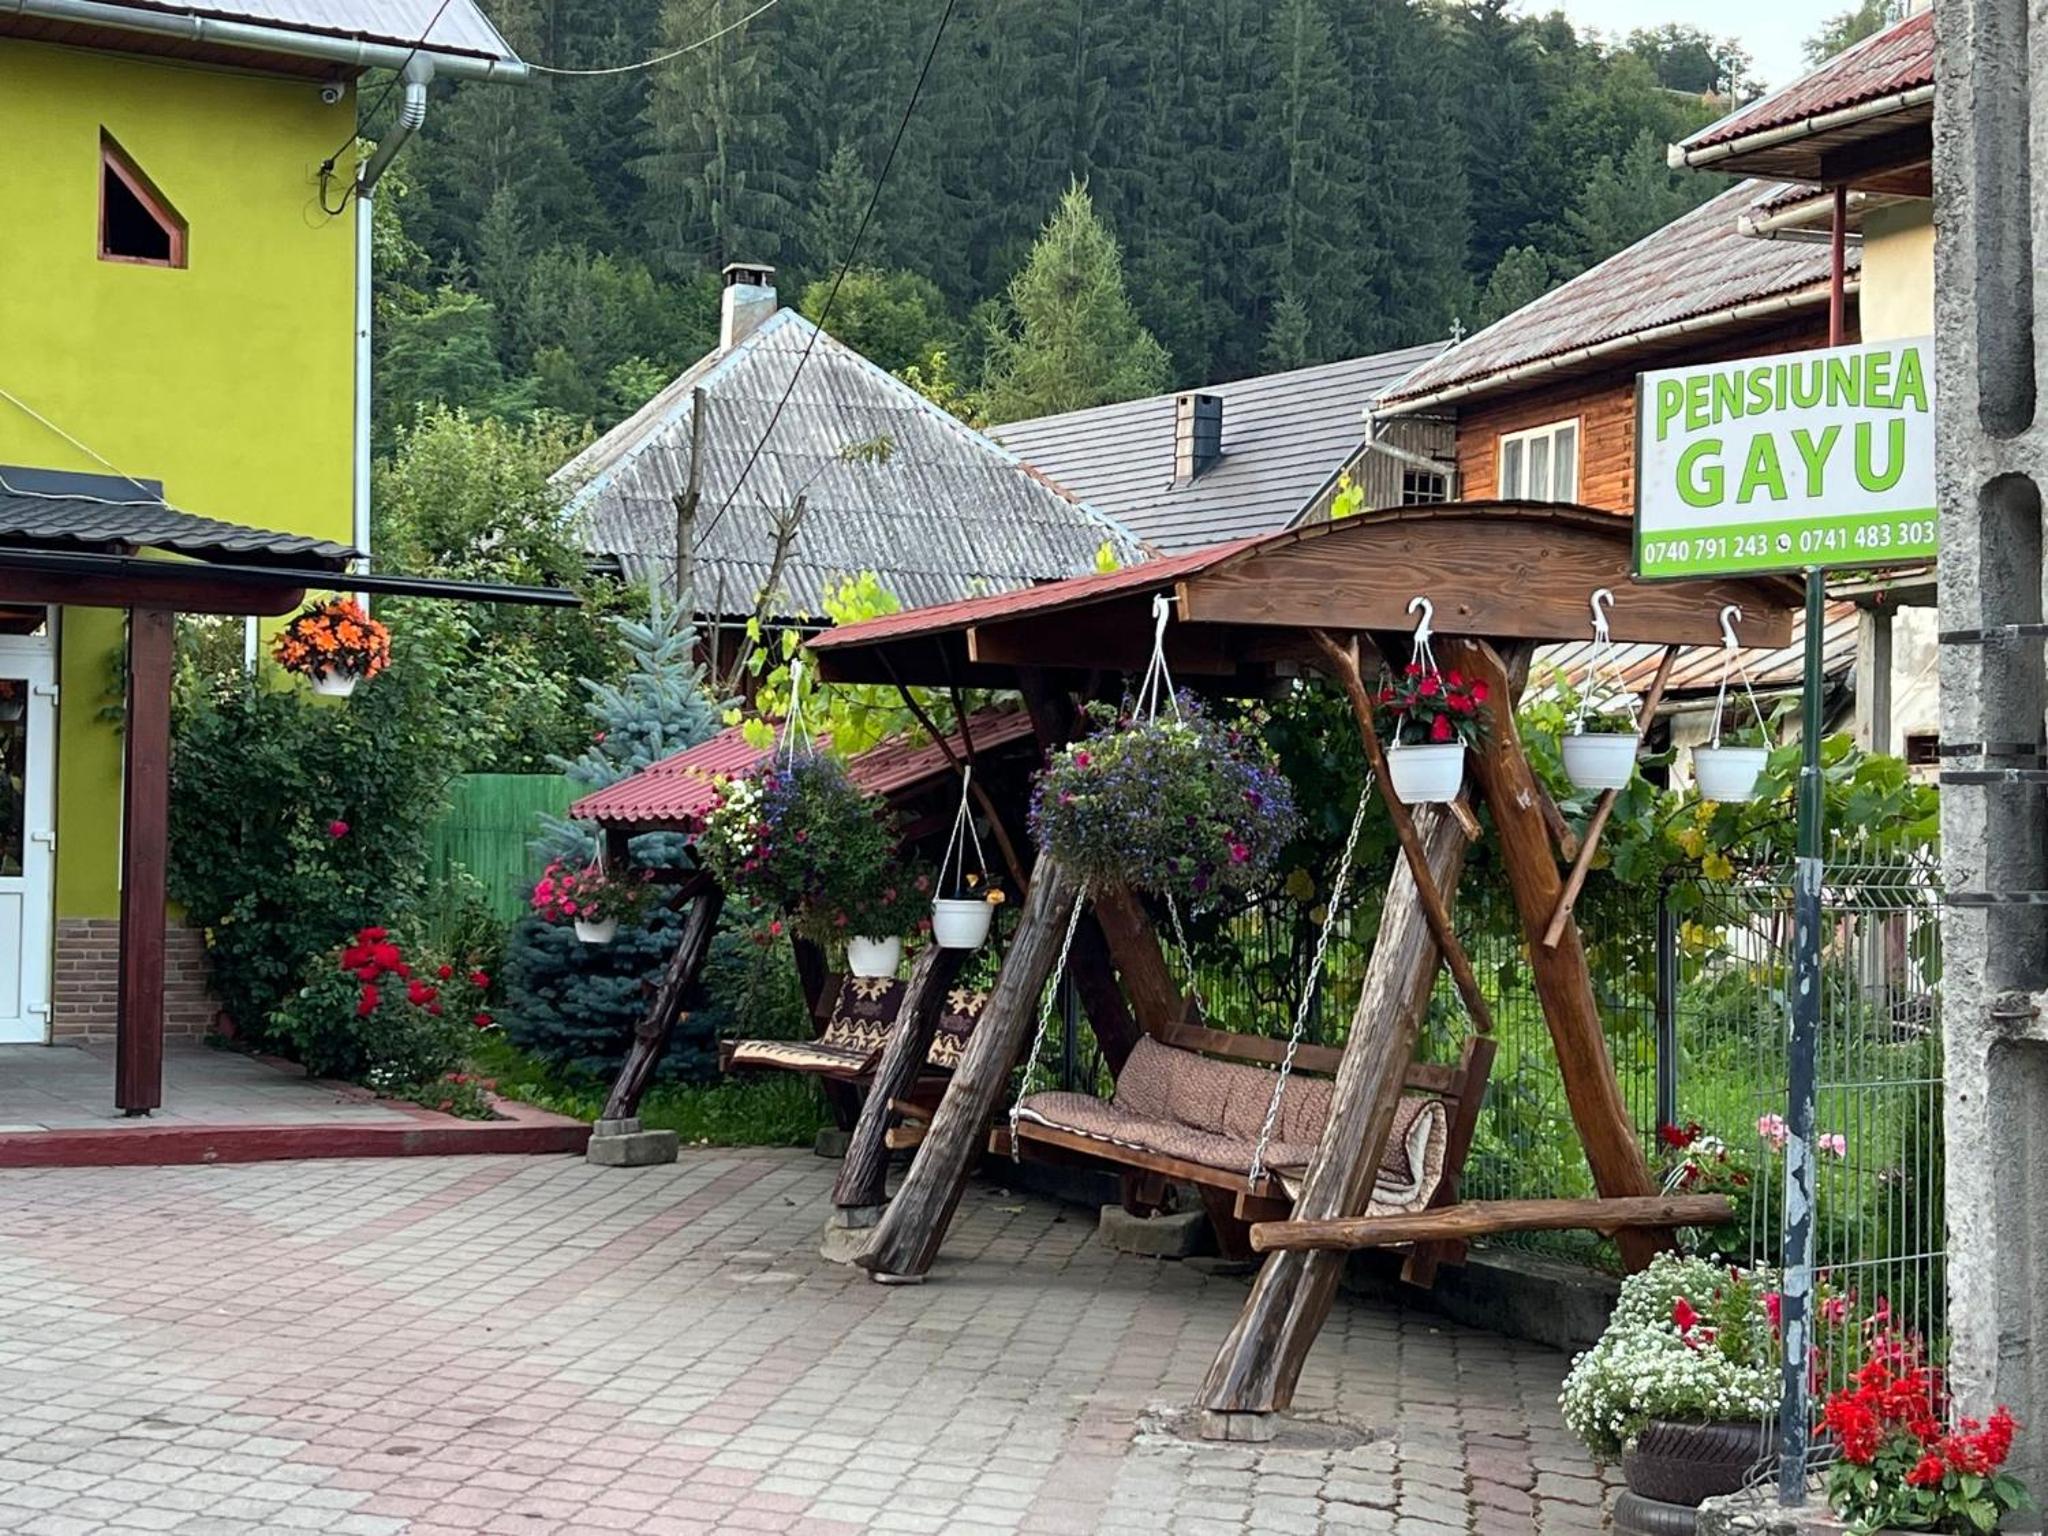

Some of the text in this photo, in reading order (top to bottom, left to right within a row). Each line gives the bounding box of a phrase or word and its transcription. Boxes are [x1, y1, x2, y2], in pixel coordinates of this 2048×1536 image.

[1656, 347, 1929, 442] PENSIUNEA
[1675, 418, 1906, 508] GAYU
[1644, 520, 1935, 564] 0740 791 243 0741 483 303
